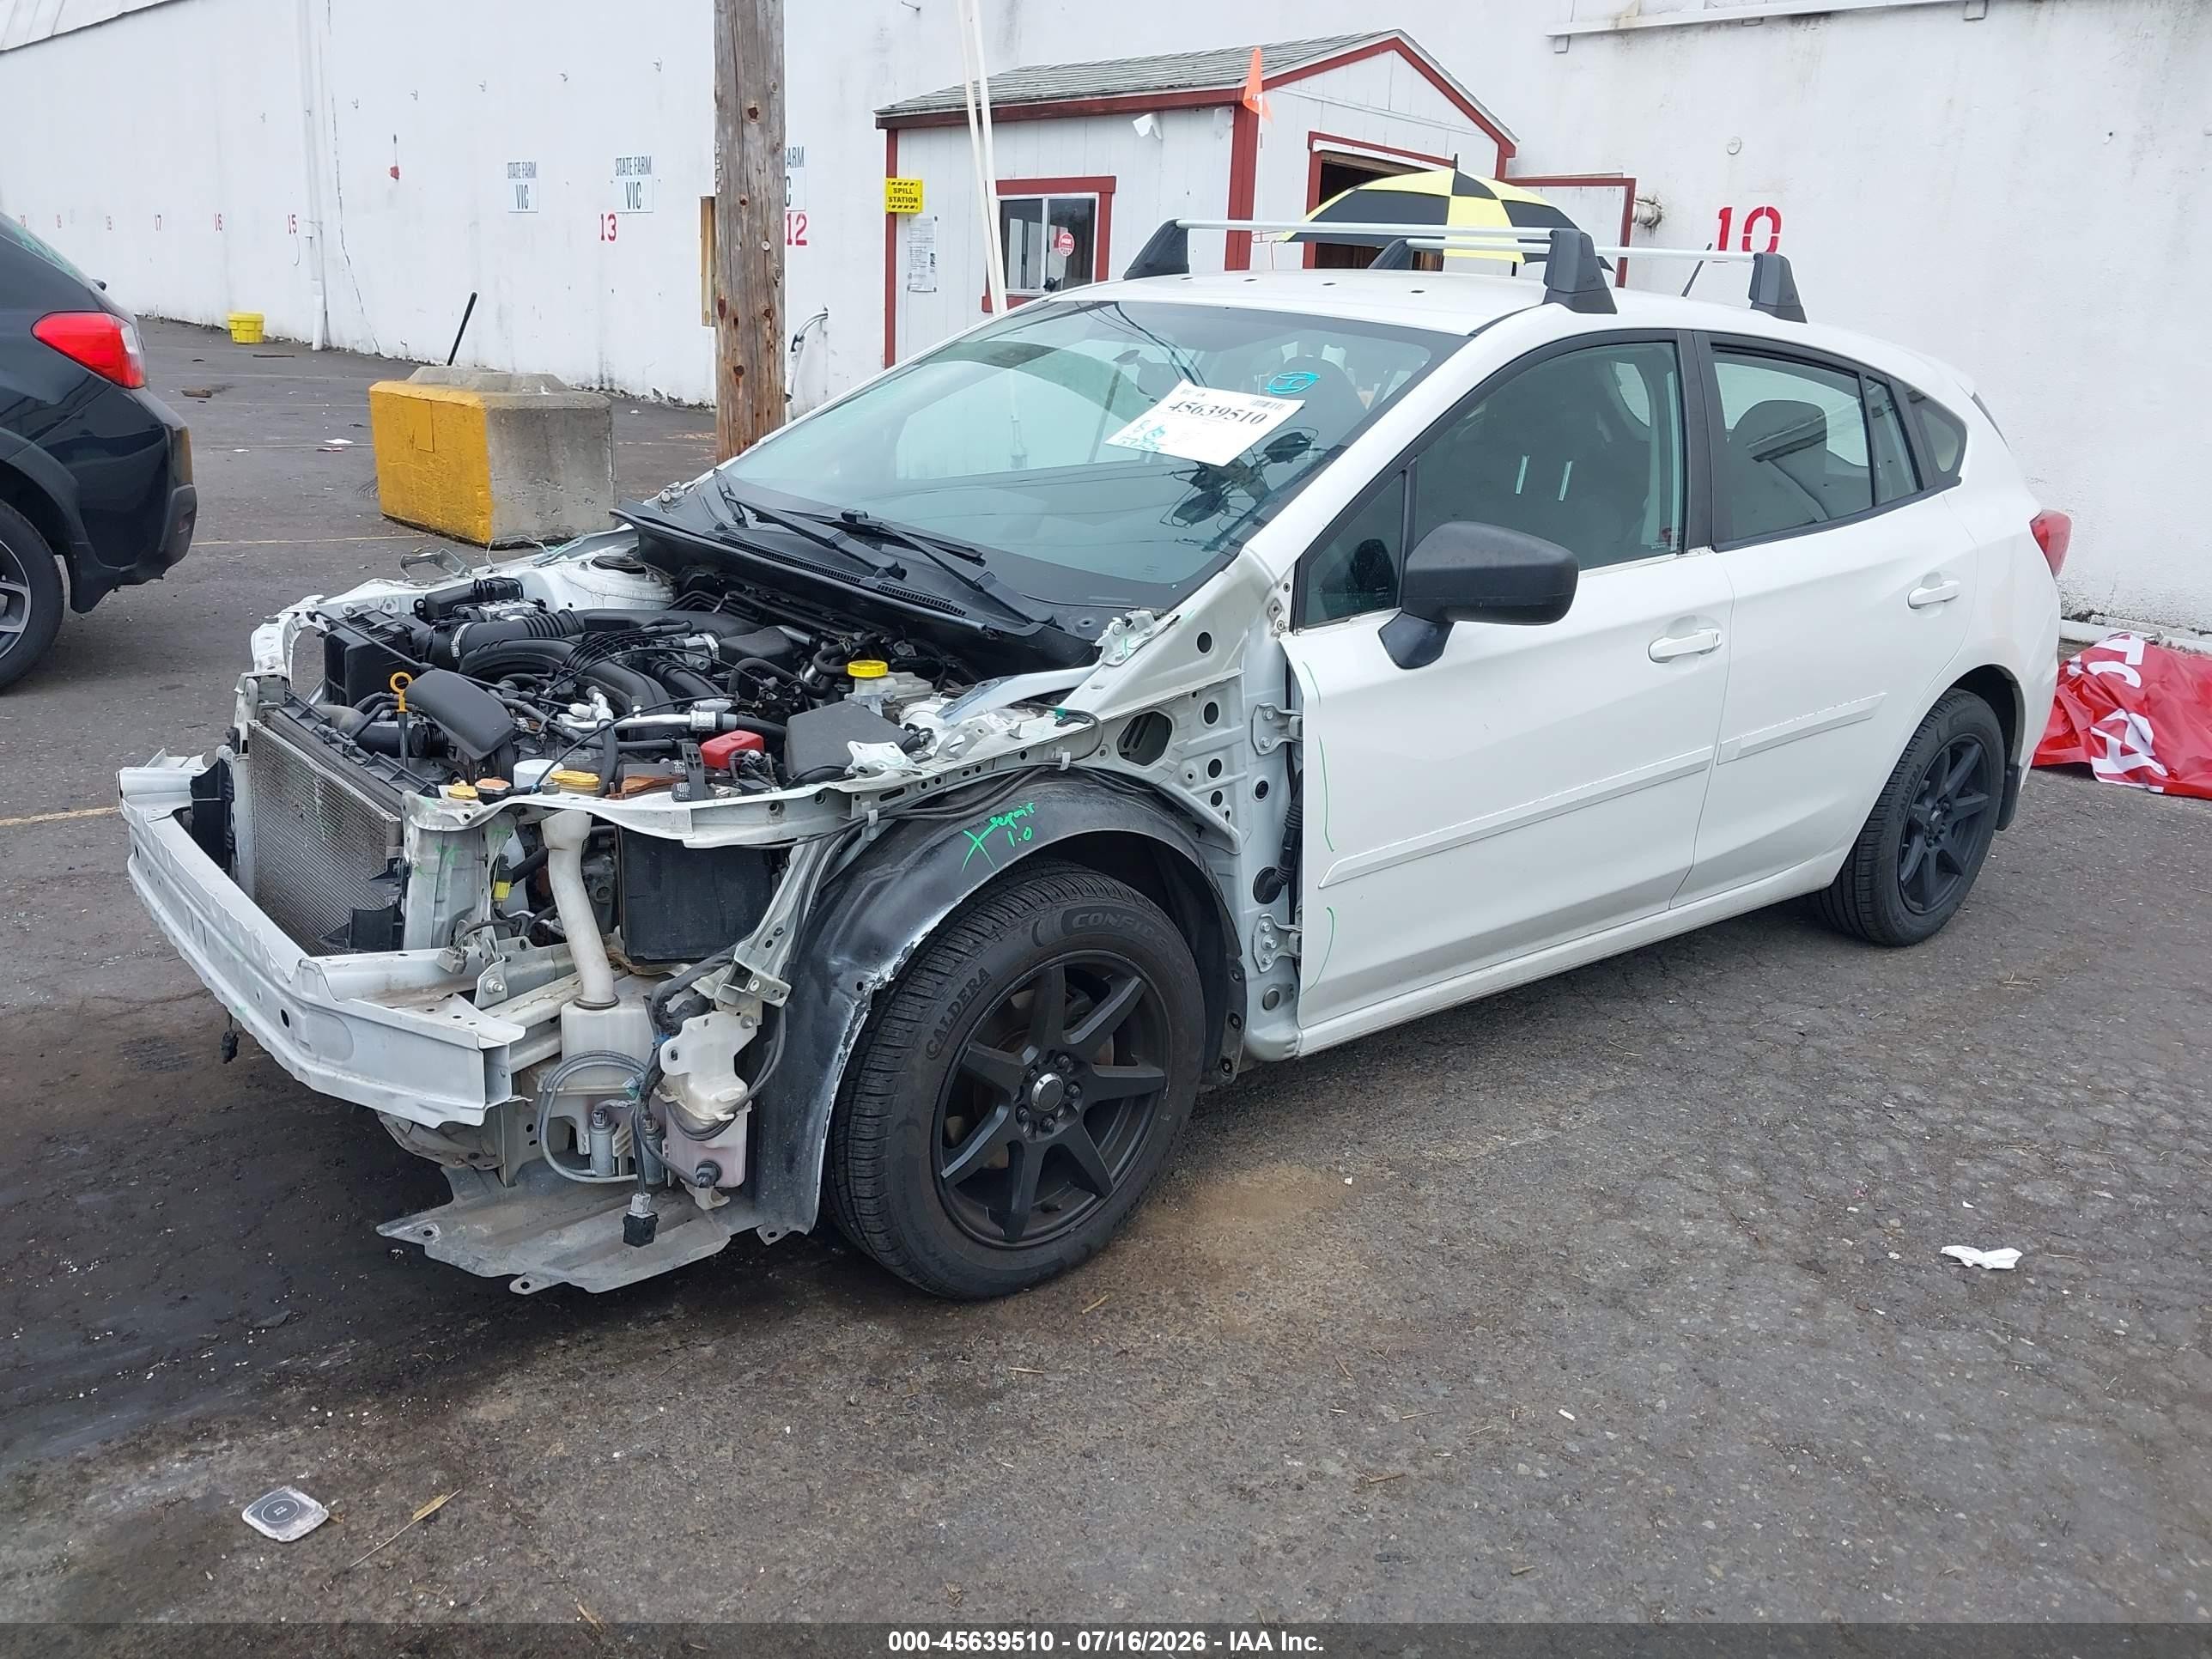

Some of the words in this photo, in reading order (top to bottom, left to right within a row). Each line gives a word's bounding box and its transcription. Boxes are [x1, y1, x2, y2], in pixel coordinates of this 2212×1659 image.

[616, 157, 633, 177] STATE
[634, 155, 653, 176] FARM
[786, 146, 805, 168] ARM
[507, 161, 520, 179] STATE
[521, 161, 537, 179] FARM
[515, 184, 529, 210] VIC
[625, 181, 642, 210] VIC
[214, 213, 223, 232] 16
[288, 214, 297, 234] 15
[600, 213, 617, 241] 13
[787, 213, 808, 246] 12
[1717, 206, 1782, 255] 10
[1169, 400, 1268, 425] 45639510
[926, 966, 991, 1061] CALDERA
